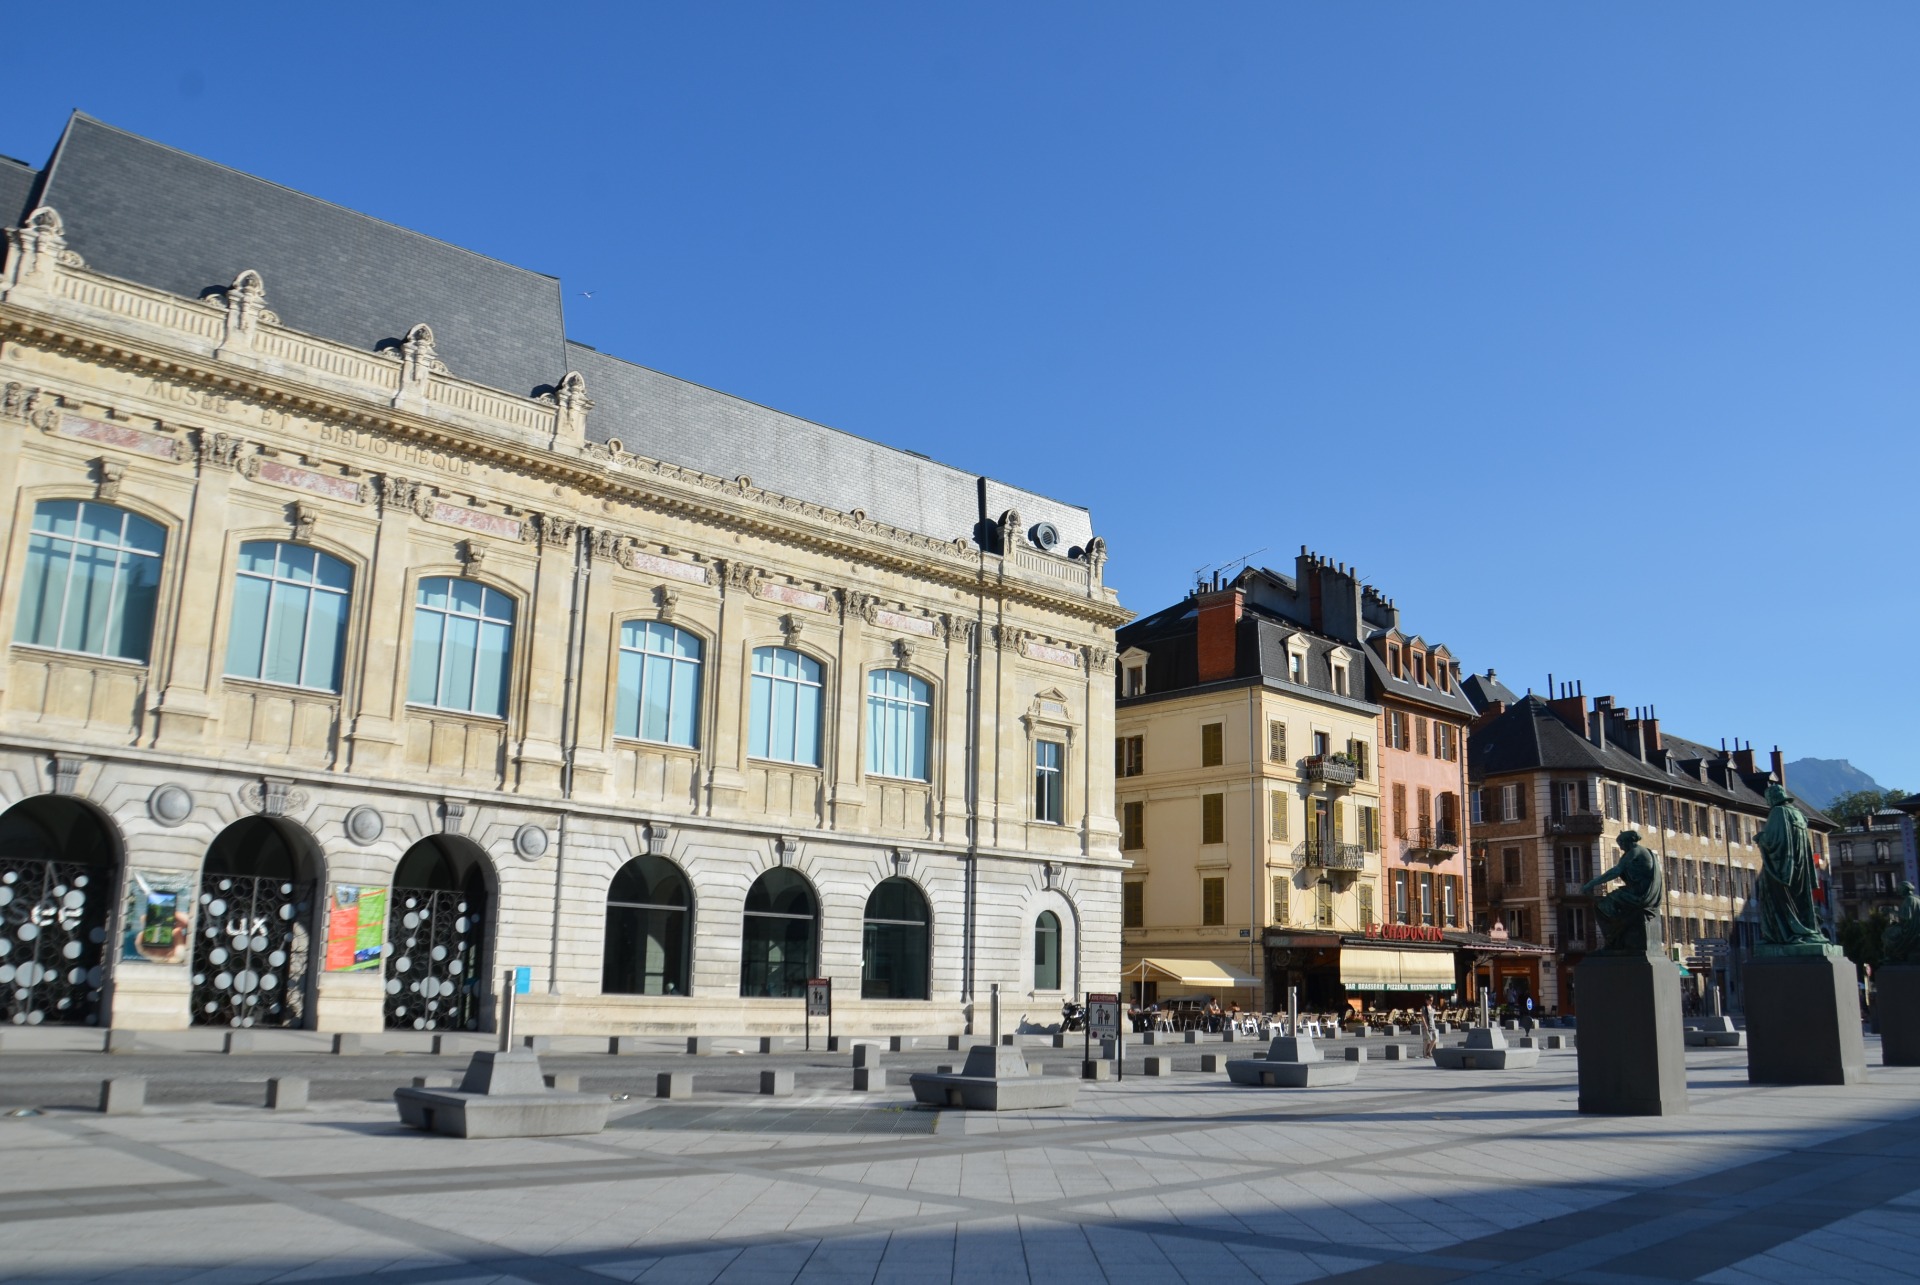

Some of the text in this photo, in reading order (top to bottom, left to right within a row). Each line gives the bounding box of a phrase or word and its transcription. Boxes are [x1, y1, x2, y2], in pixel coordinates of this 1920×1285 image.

[261, 408, 291, 430] ET
[1366, 923, 1443, 941] LE CHAPON FIN
